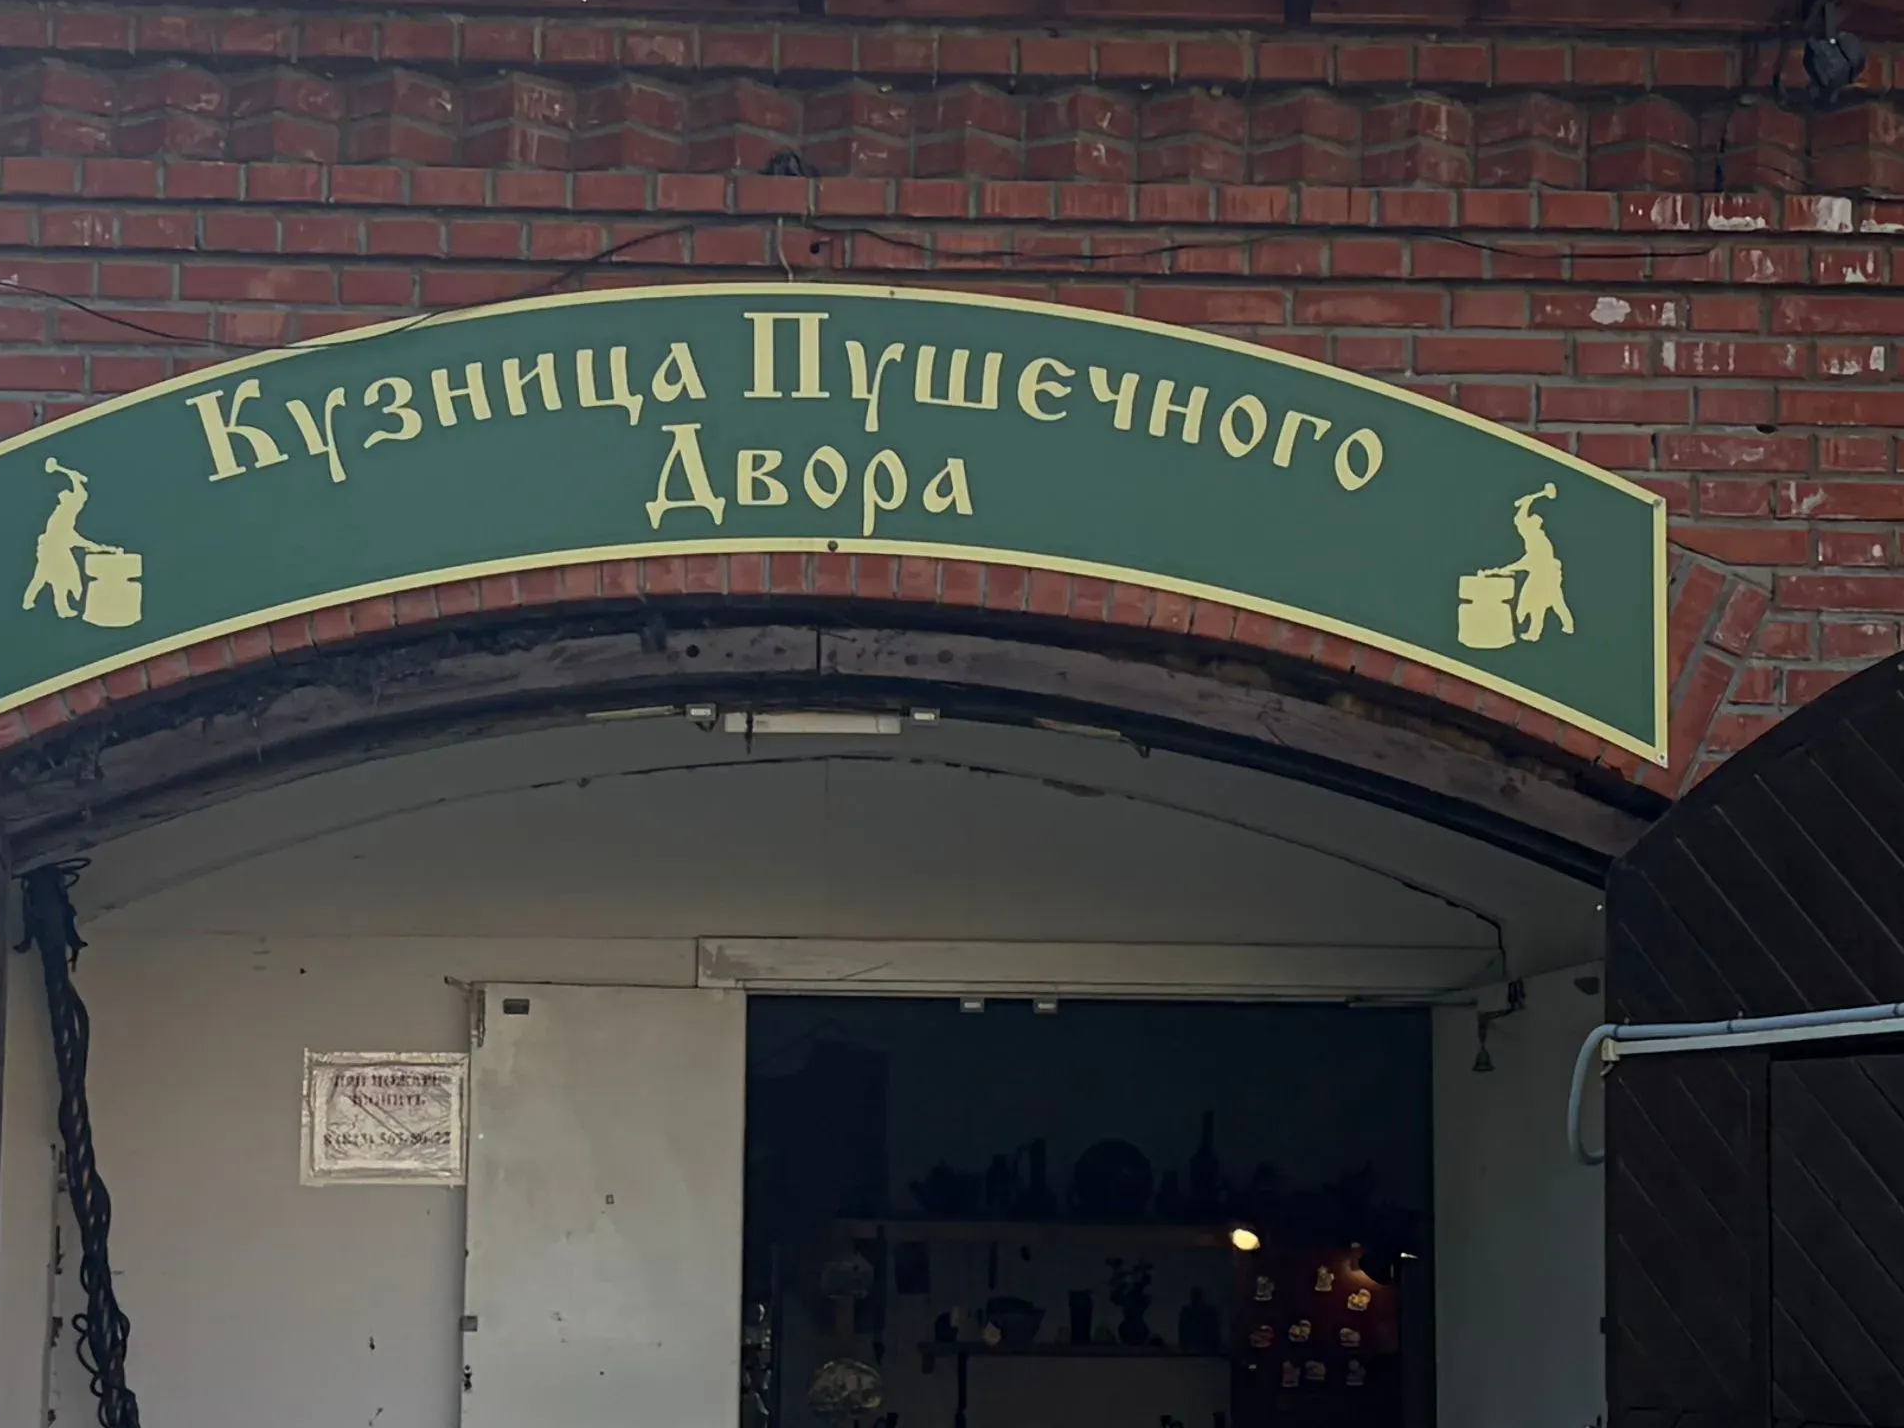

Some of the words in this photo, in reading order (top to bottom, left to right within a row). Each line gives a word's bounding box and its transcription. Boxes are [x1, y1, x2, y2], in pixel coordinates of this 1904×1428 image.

[185, 341, 707, 484] Кузница
[743, 311, 1384, 492] Пушечного
[645, 422, 974, 537] Двора
